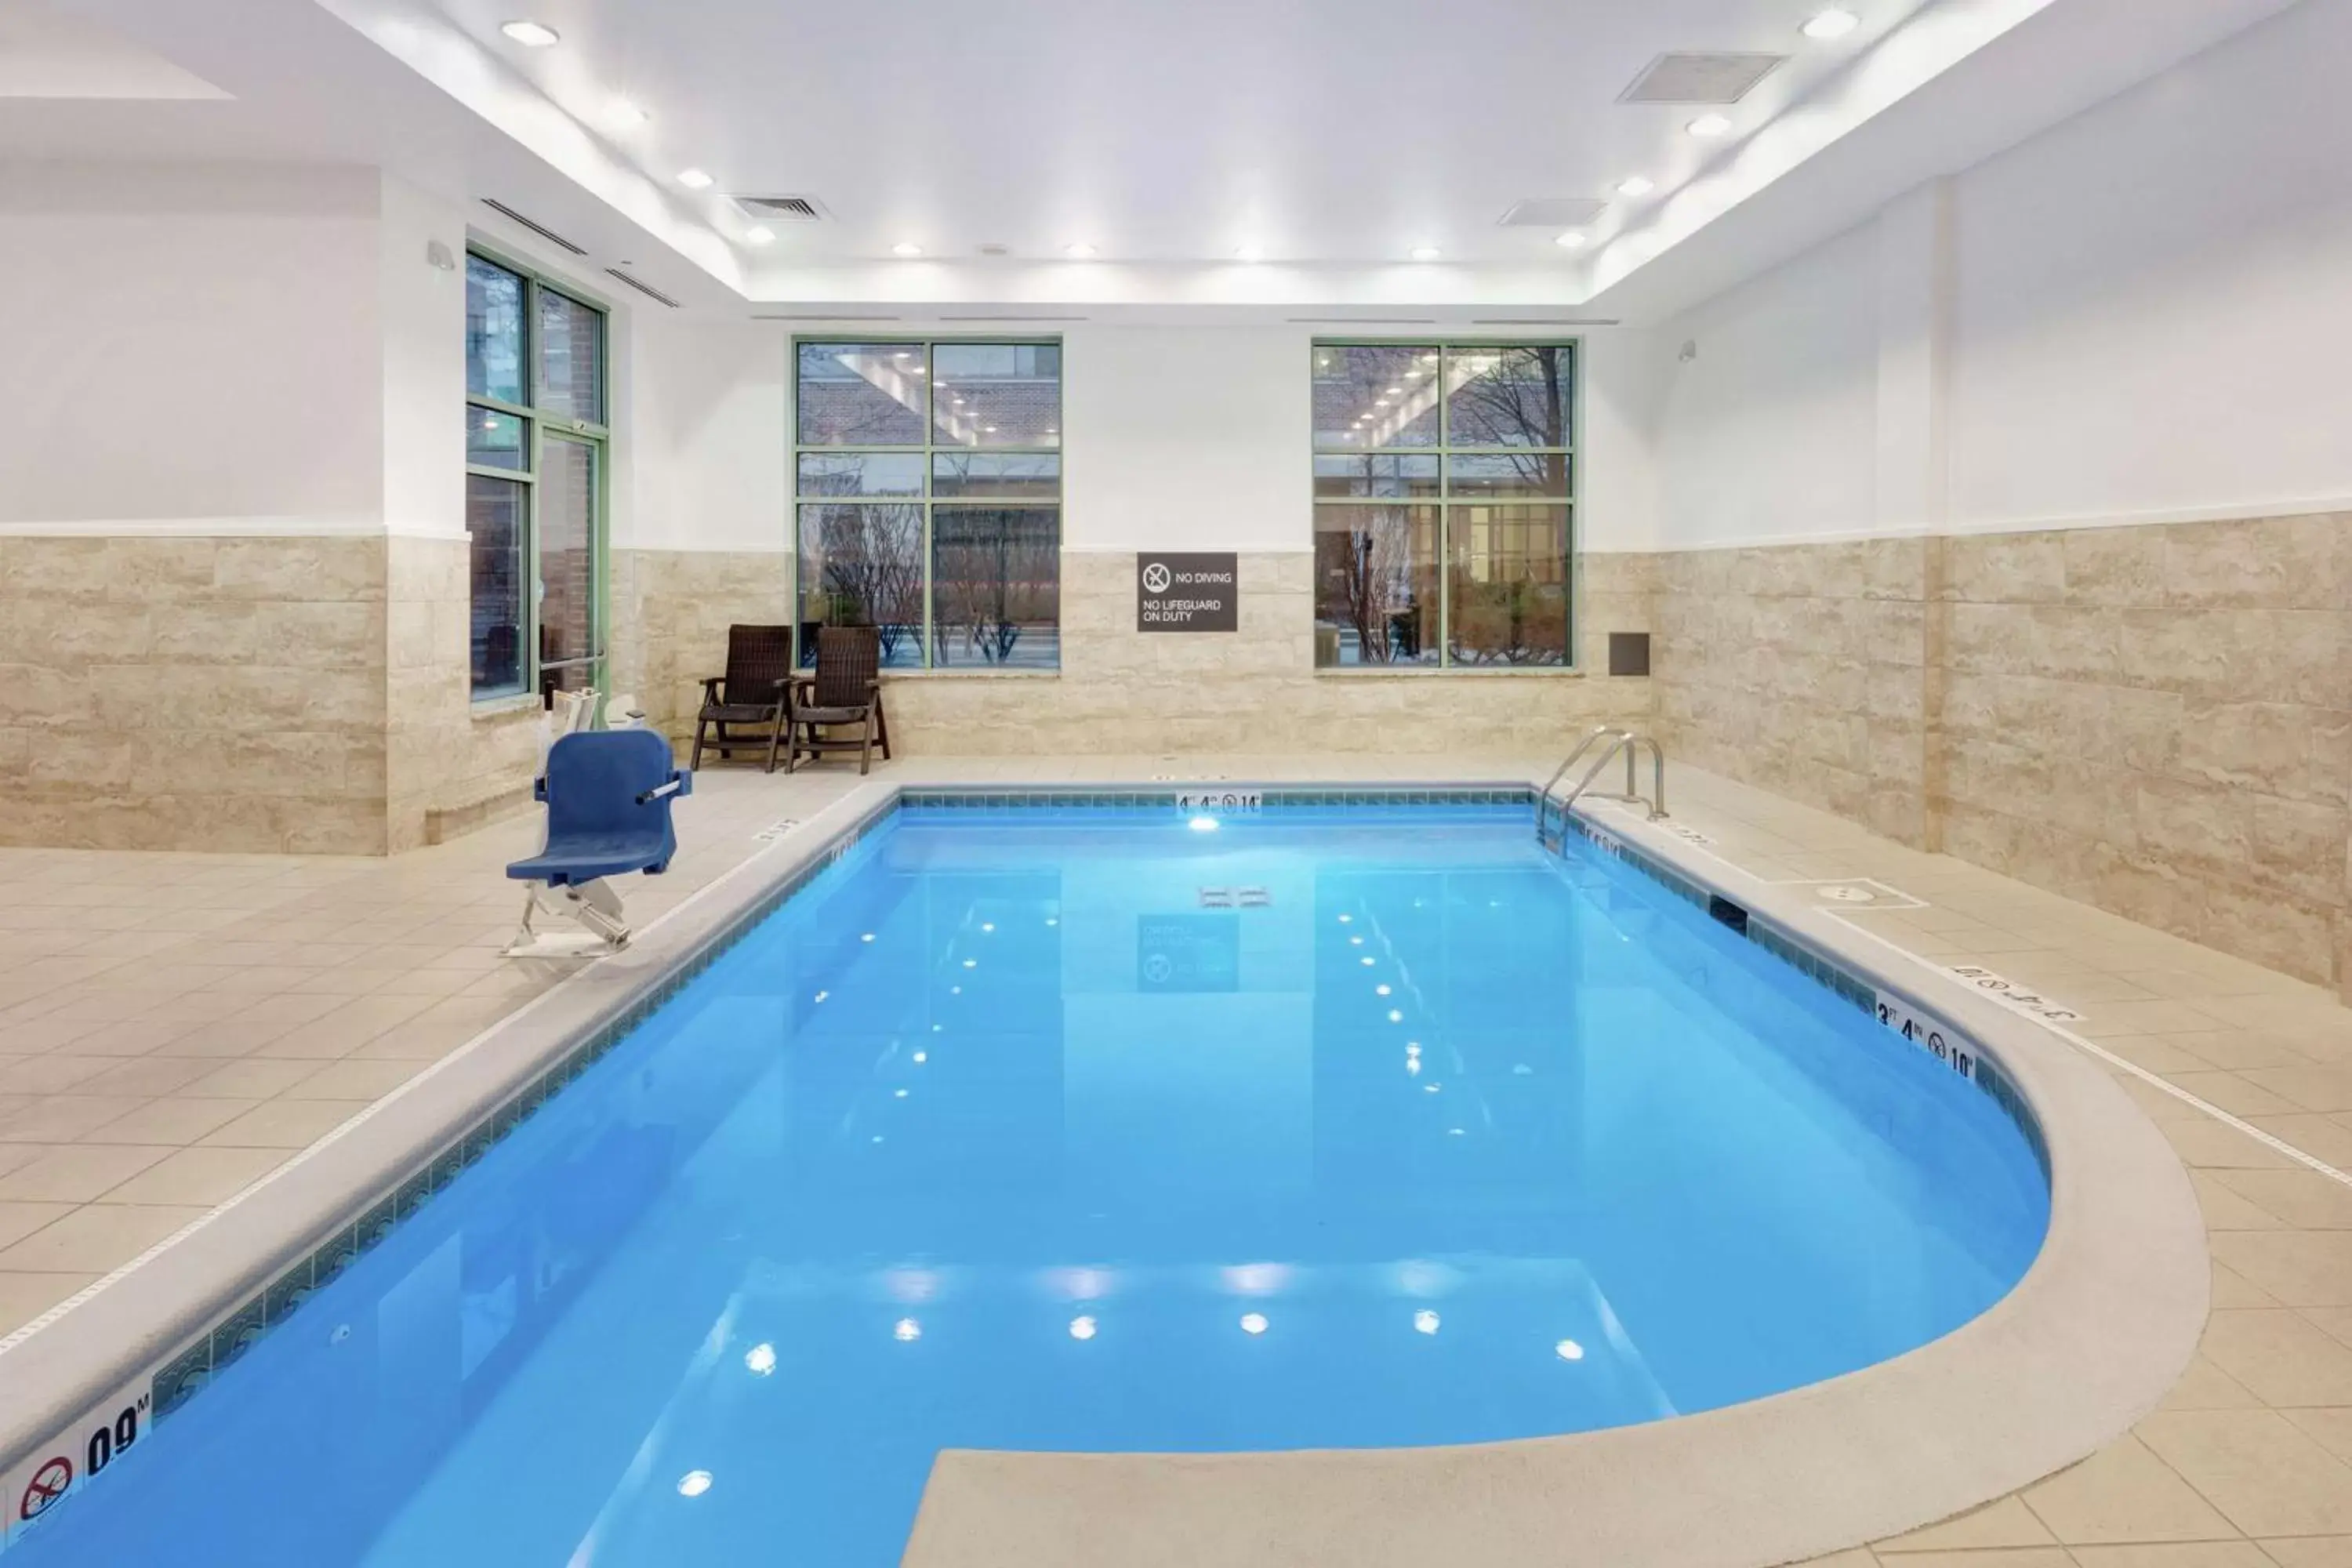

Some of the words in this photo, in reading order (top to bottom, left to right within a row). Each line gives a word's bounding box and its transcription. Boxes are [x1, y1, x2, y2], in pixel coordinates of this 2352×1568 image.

[1176, 573, 1192, 583] NO
[1195, 573, 1232, 583] DIVING
[1143, 600, 1160, 611] NO
[1163, 600, 1221, 611] LIFEGUARD
[1143, 611, 1160, 622] ON
[1163, 611, 1192, 622] DUTY
